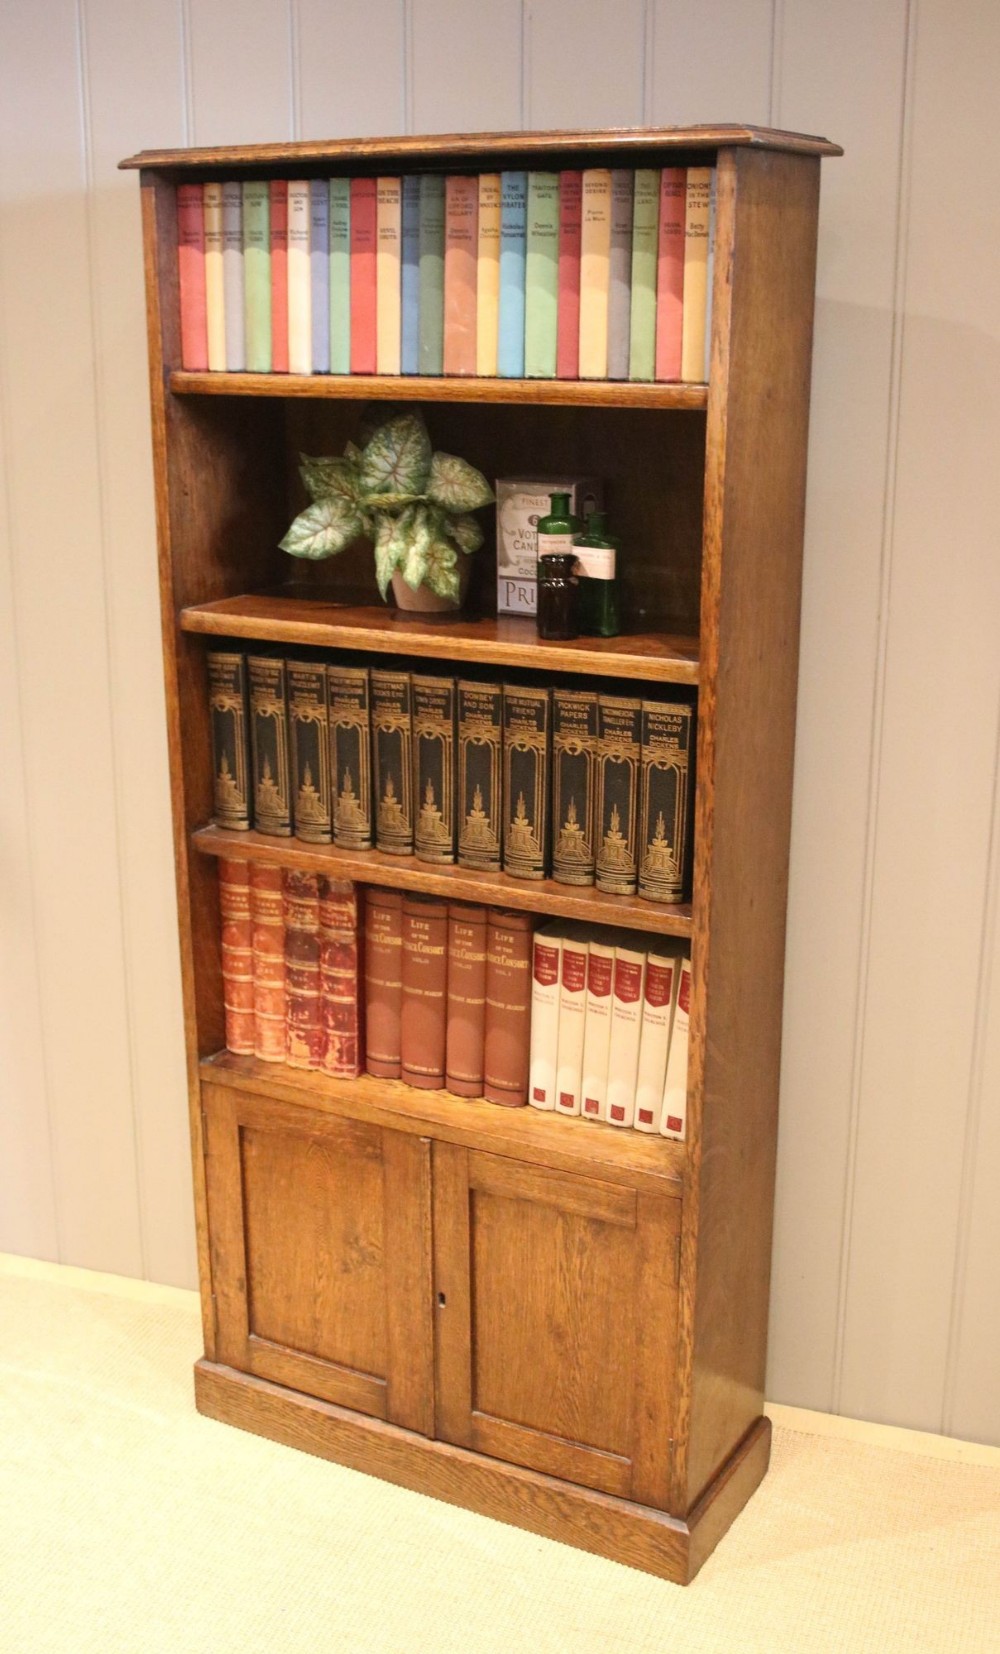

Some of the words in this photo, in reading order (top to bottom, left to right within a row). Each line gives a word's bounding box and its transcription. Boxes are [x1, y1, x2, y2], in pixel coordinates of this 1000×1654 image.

[688, 201, 709, 209] STEW
[690, 222, 705, 231] Betty
[521, 498, 550, 507] FINEST
[506, 582, 535, 607] PRI
[464, 692, 493, 702] DOMBEY
[464, 700, 478, 709] AND
[479, 702, 494, 711] SON
[558, 701, 590, 712] PICKWICK
[465, 712, 492, 720] CHARLES
[512, 706, 536, 716] FRIEND
[560, 710, 588, 720] PAPERS
[510, 717, 537, 726] CHARLES
[648, 713, 682, 724] NICHOLAS
[560, 722, 588, 730] CHARLES
[647, 722, 683, 733] NICKLEBY
[604, 728, 632, 738] CHARLES
[604, 735, 632, 744] DICKENS
[650, 734, 679, 743] CHARLES
[649, 741, 679, 750] DICKENS
[373, 910, 391, 921] LIFE
[411, 919, 430, 931] LIFE
[455, 924, 473, 937] LIFE
[495, 931, 514, 944] LIFE
